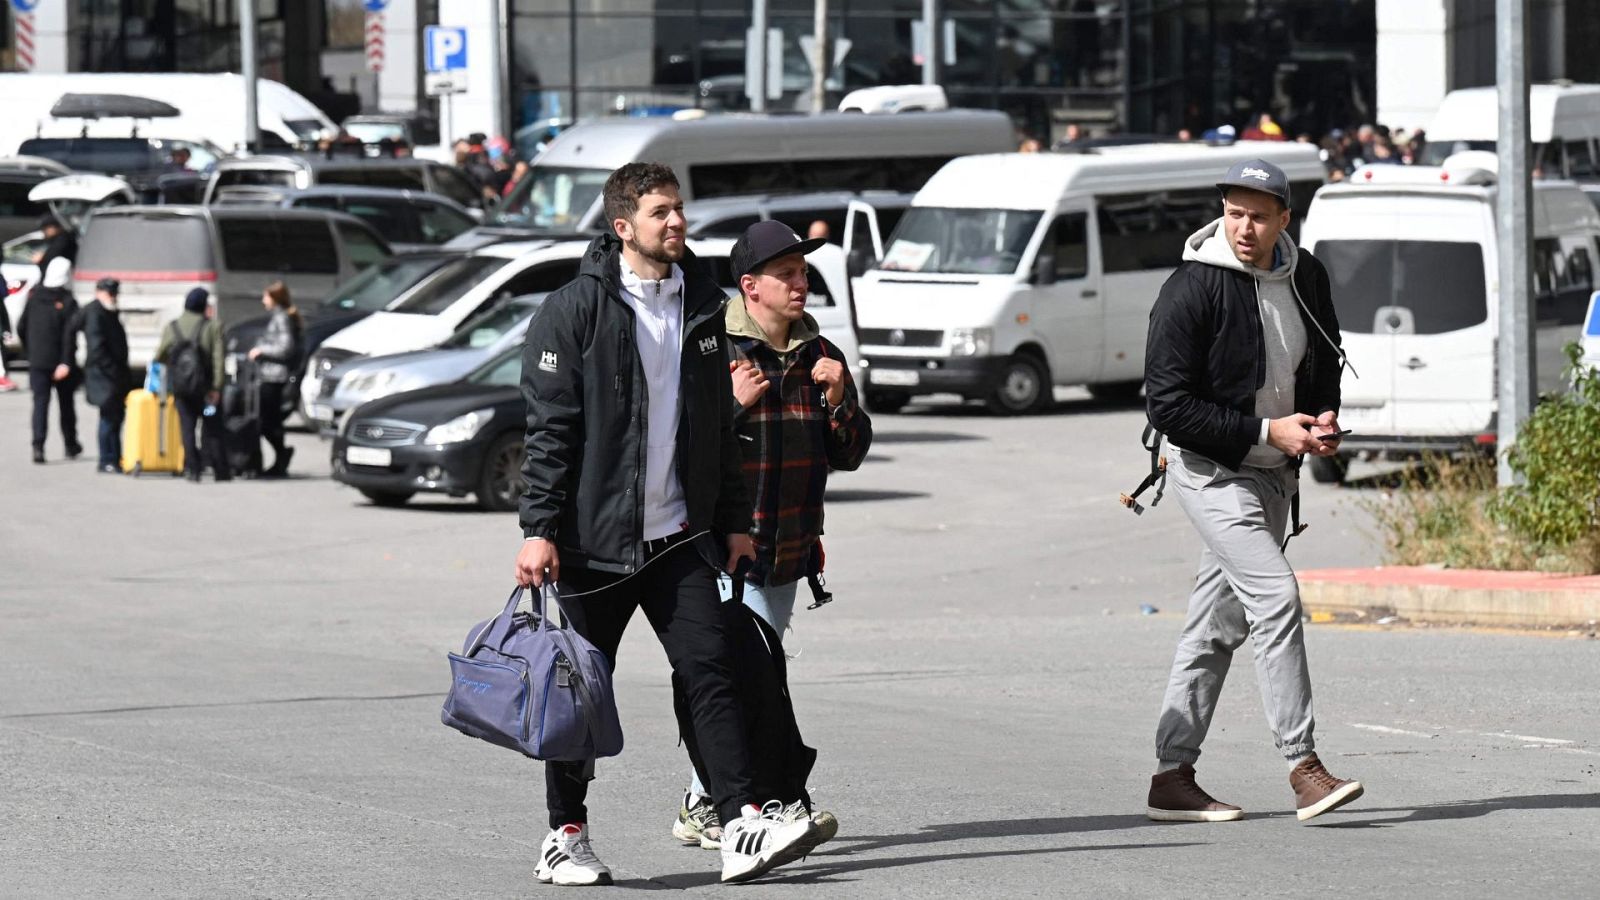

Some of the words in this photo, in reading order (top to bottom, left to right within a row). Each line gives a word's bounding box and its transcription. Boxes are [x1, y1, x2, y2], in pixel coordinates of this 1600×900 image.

[432, 30, 463, 68] P
[699, 336, 717, 351] HH
[541, 351, 557, 364] HH
